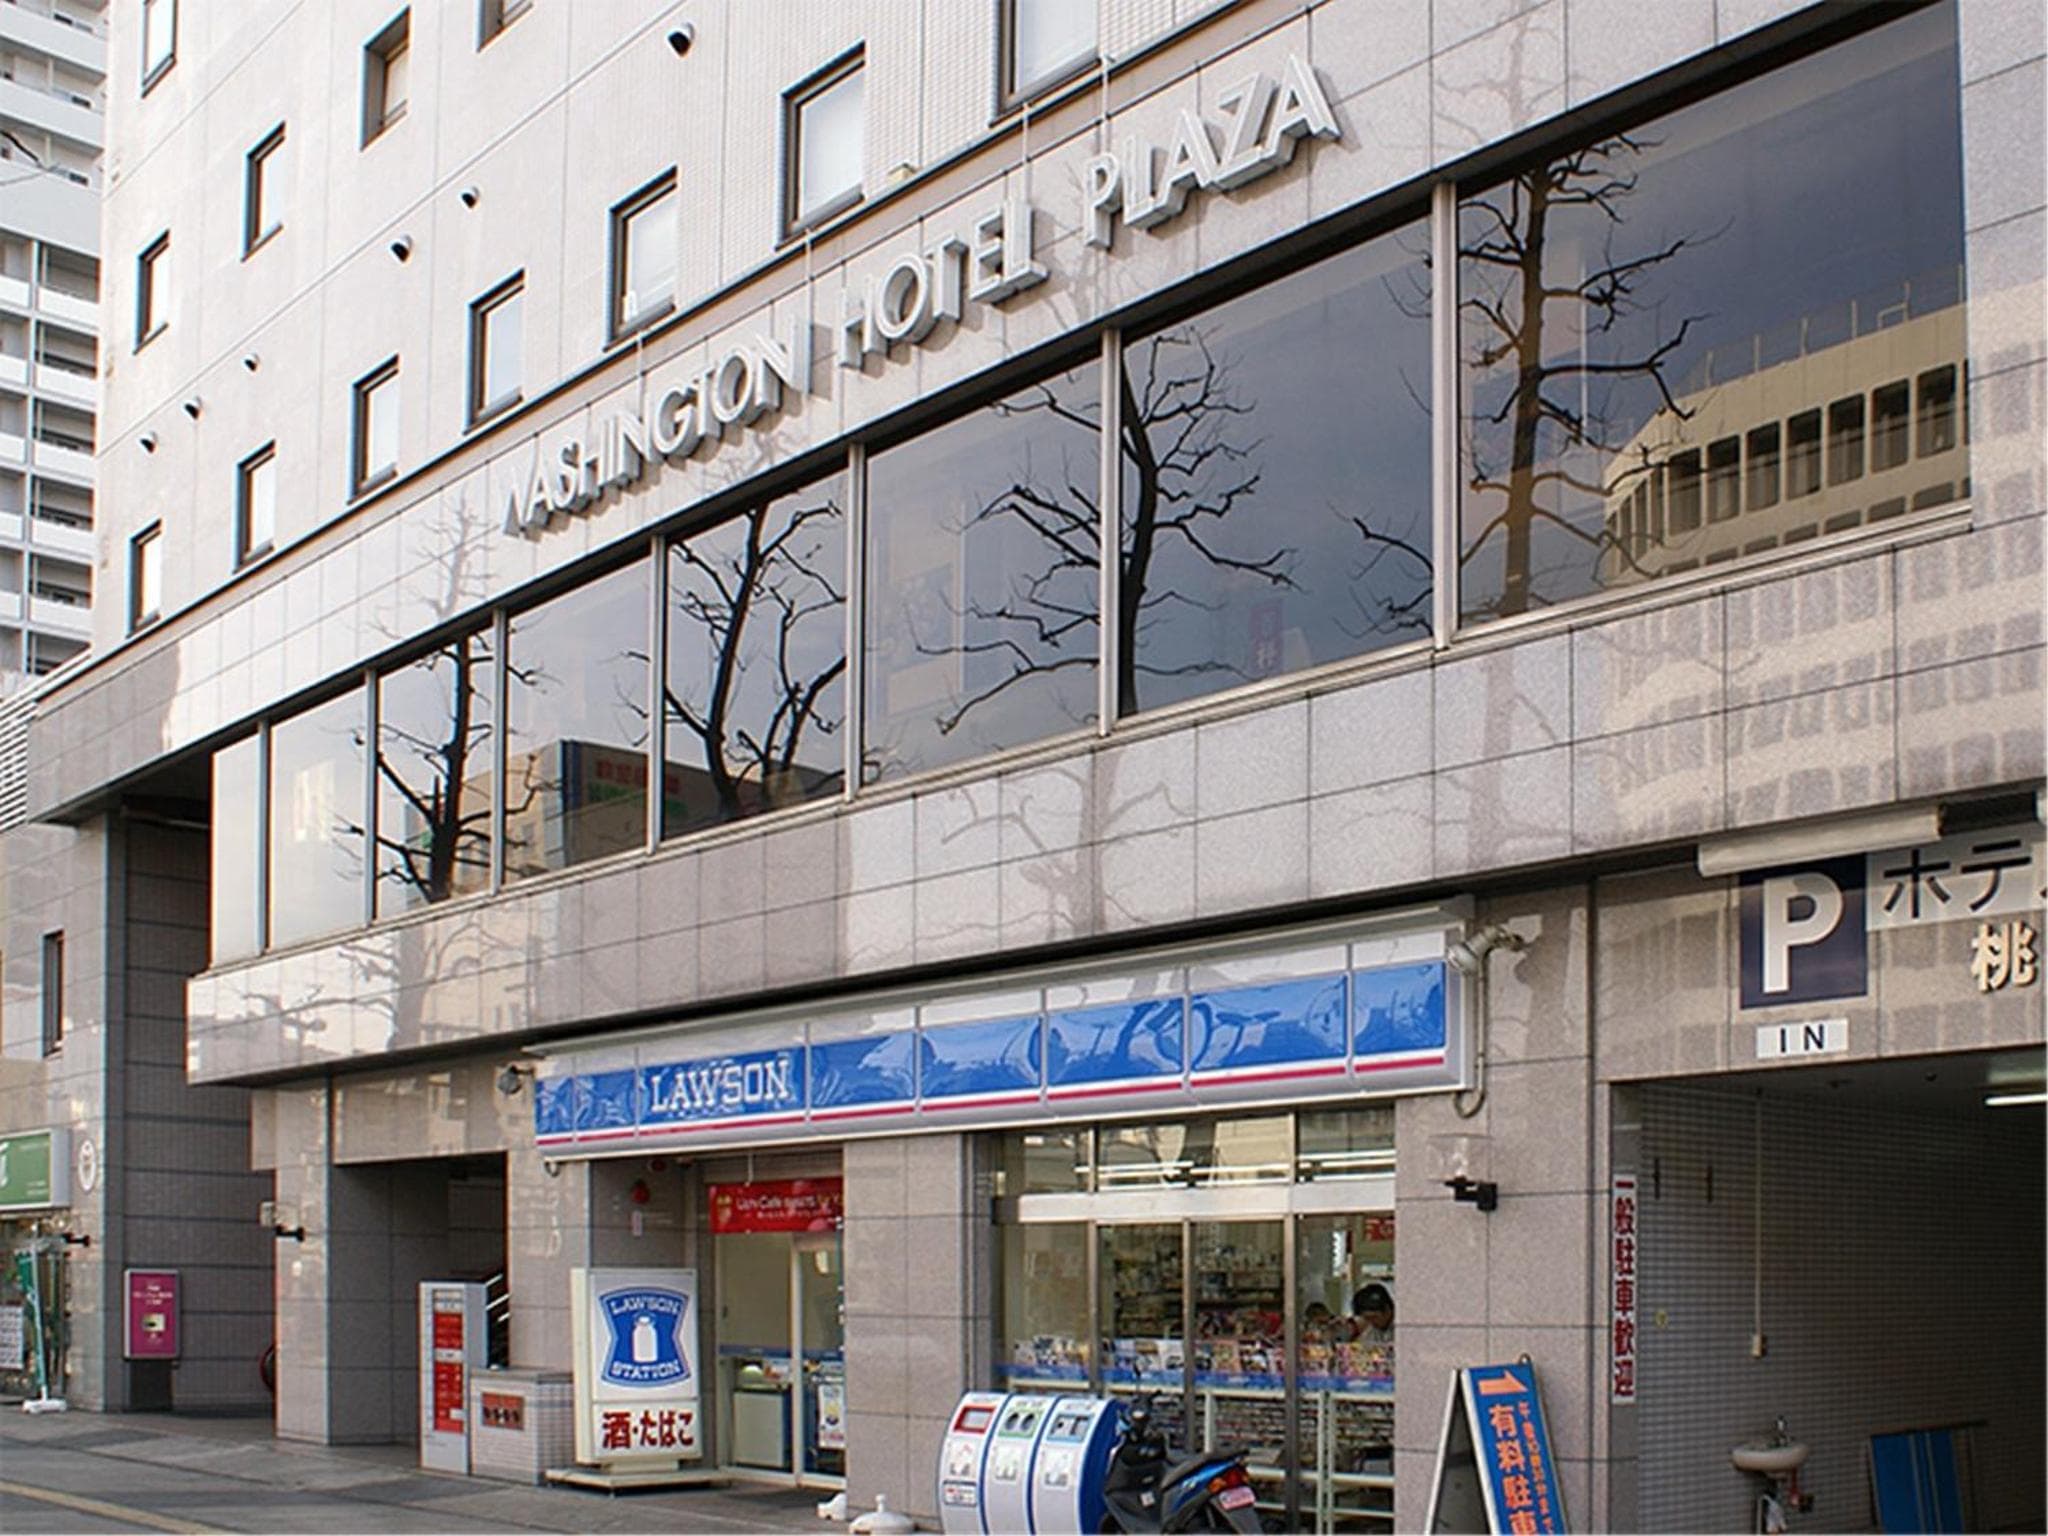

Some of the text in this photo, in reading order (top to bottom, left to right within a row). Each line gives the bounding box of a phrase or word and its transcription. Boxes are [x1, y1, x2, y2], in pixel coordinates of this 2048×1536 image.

[503, 53, 1342, 537] WASHINGTON HOTEL PLAZA
[1882, 839, 2047, 919] ホテ
[1763, 872, 1843, 993] P
[1970, 921, 2038, 993] 桃
[1778, 1024, 1825, 1053] IN
[652, 1060, 789, 1112] LAWSON
[610, 1296, 680, 1315] LAWSON
[1614, 1180, 1635, 1396] 一般駐車歓迎
[612, 1359, 681, 1380] STATION
[602, 1410, 694, 1449] 酒・たばこ
